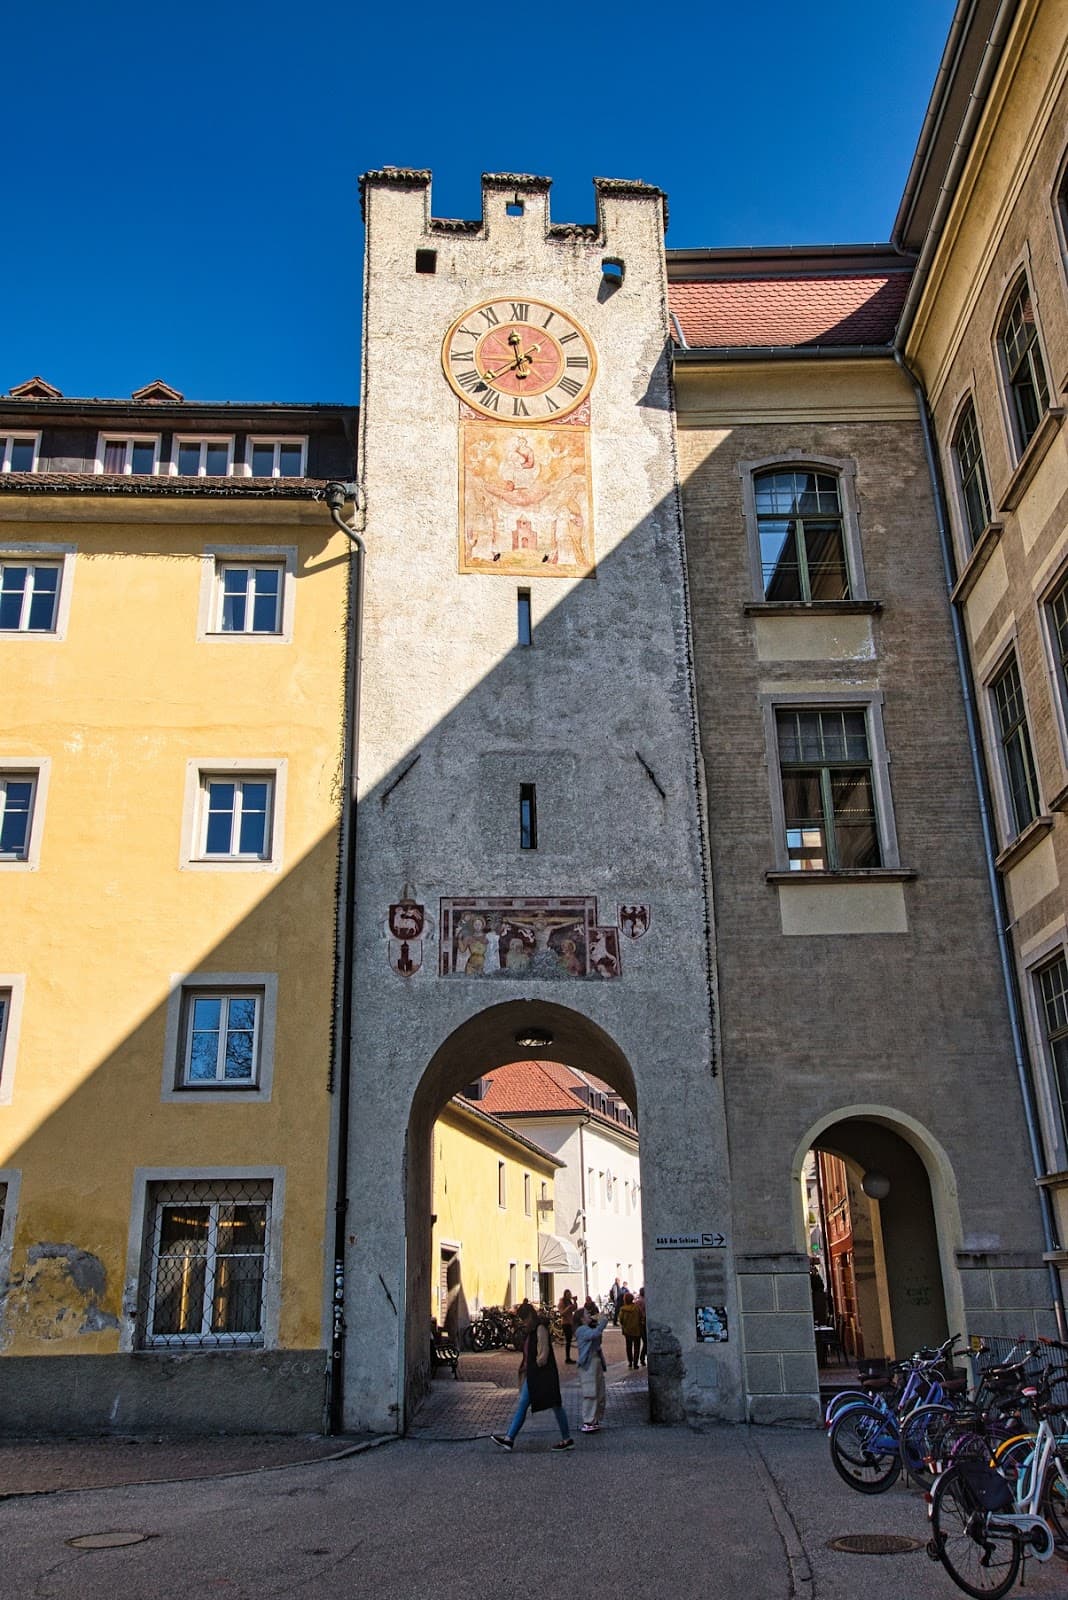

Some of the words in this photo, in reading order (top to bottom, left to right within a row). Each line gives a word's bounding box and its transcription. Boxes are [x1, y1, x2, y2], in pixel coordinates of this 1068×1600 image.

[478, 307, 500, 328] XI
[509, 303, 530, 321] XII
[543, 312, 555, 329] I
[458, 325, 482, 340] X
[559, 332, 579, 344] II
[567, 356, 588, 368] III
[512, 398, 530, 416] VI
[545, 395, 560, 412] V
